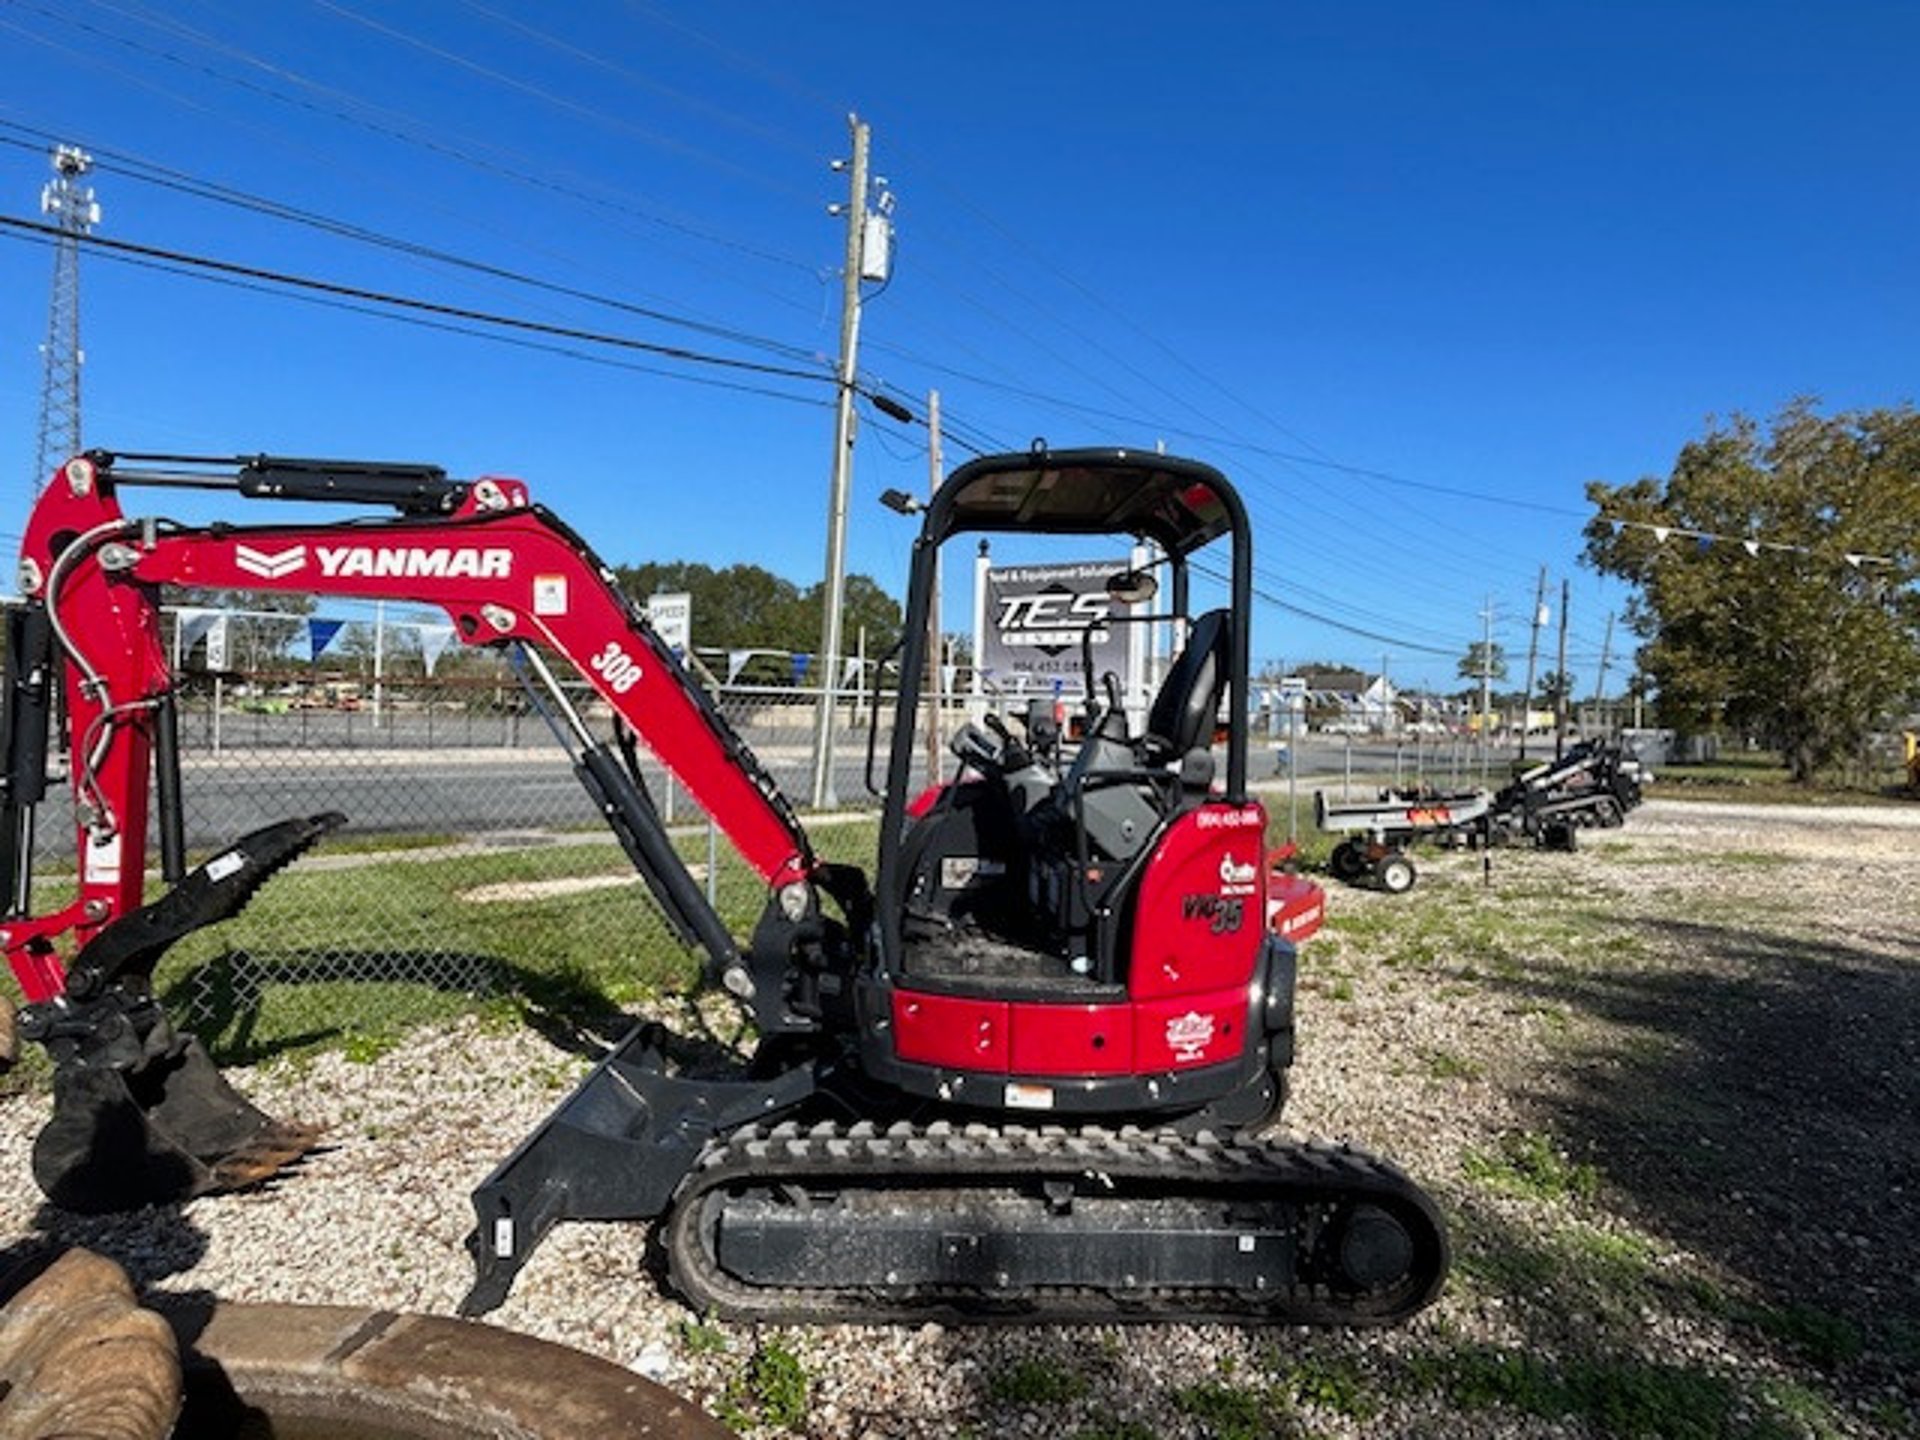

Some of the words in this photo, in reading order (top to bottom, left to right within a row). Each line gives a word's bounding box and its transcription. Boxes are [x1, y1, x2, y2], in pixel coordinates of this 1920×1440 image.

[315, 547, 513, 577] YANMAR
[651, 604, 685, 618] SPEED
[590, 641, 643, 694] 308
